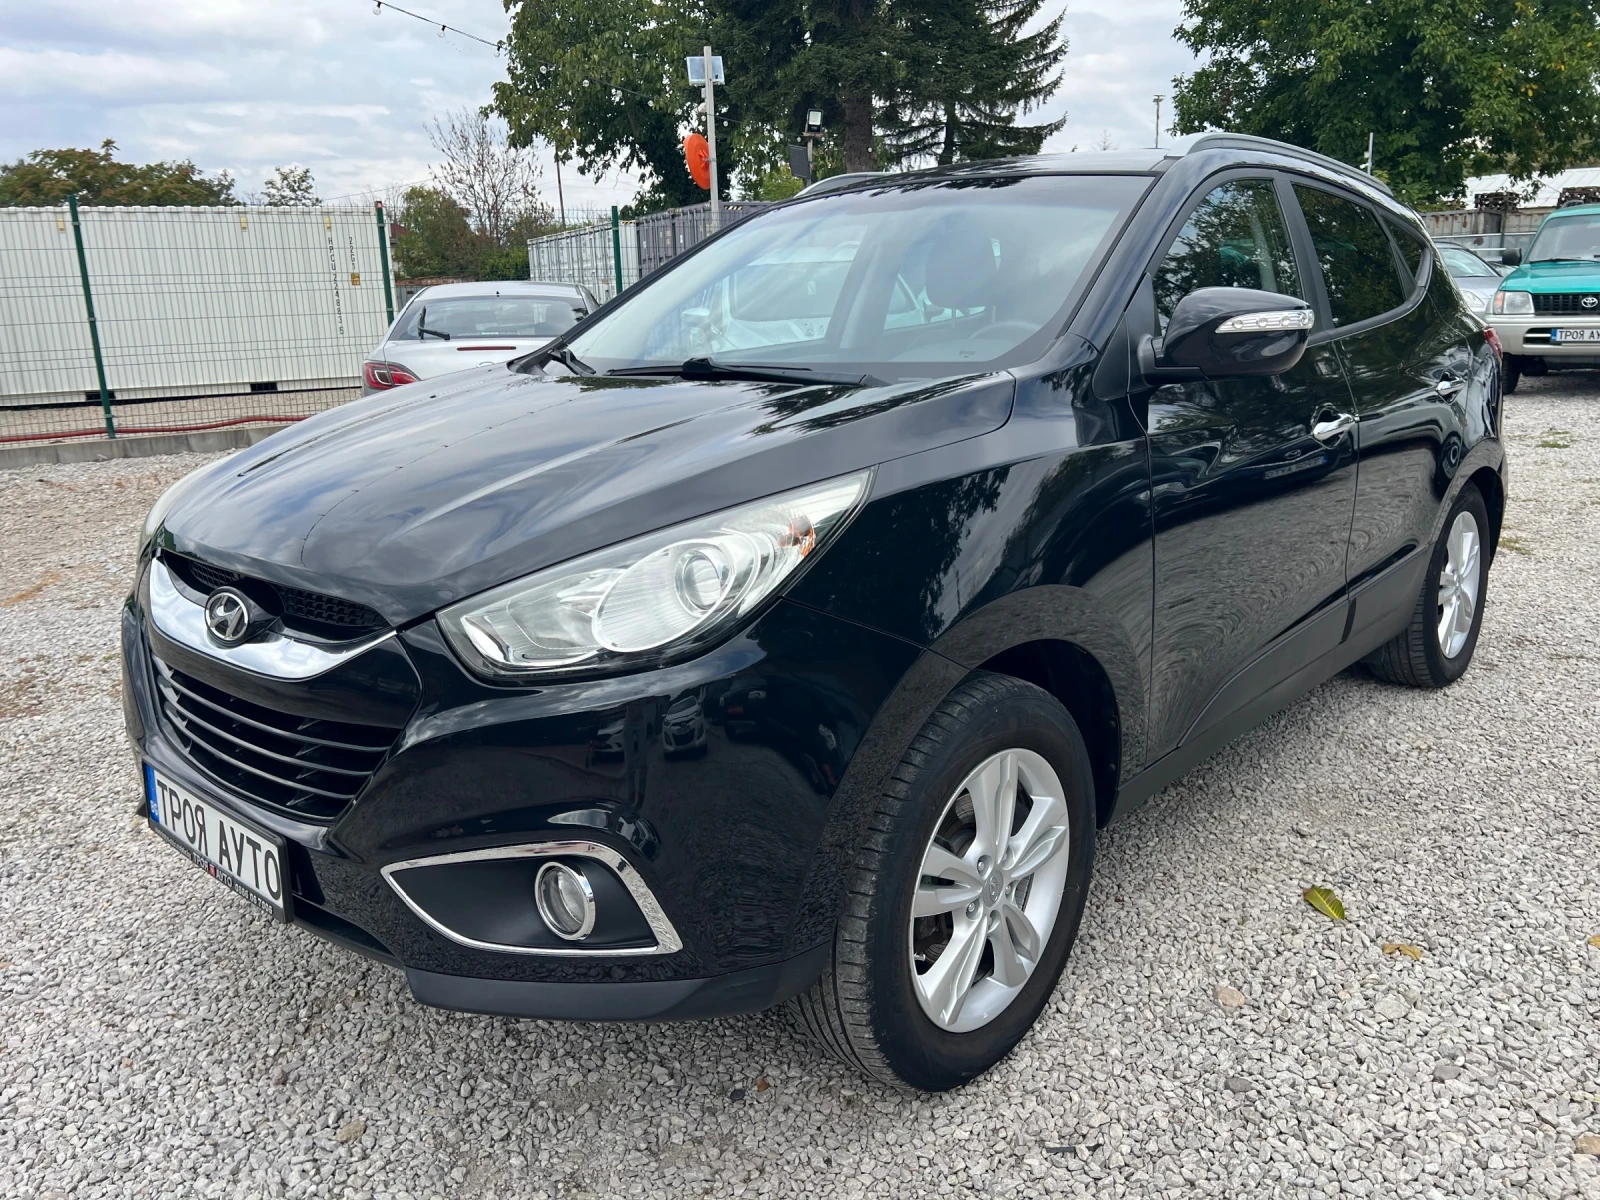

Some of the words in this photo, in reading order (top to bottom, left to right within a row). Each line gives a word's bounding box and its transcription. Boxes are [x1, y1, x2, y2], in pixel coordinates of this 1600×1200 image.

[1558, 330, 1585, 340] ТРОЯ
[157, 779, 209, 857] ТРОЯ
[218, 819, 282, 901] АУТО
